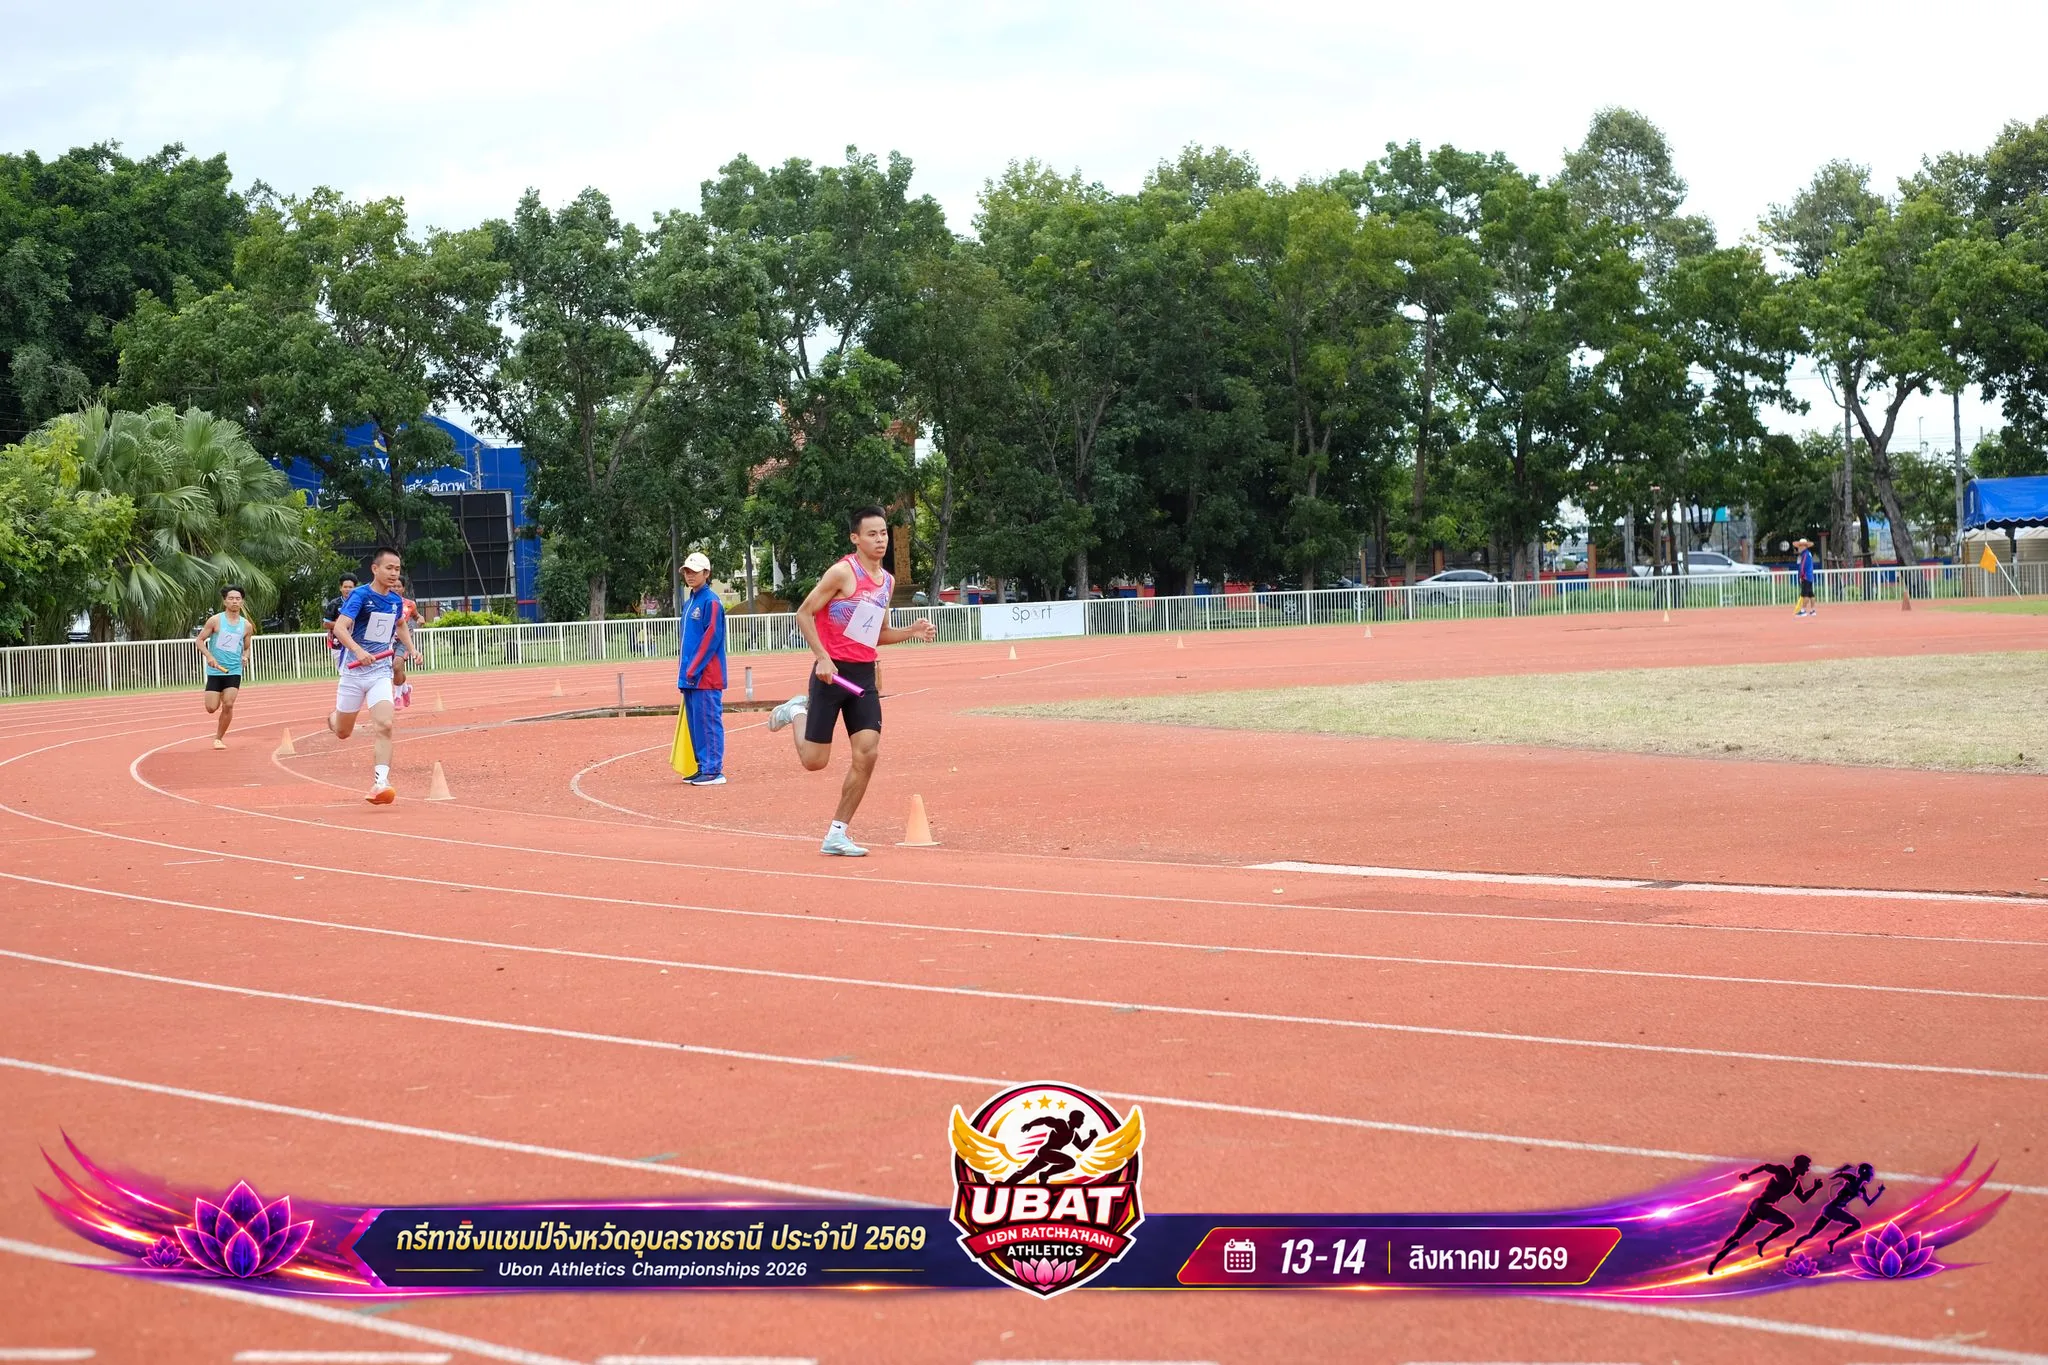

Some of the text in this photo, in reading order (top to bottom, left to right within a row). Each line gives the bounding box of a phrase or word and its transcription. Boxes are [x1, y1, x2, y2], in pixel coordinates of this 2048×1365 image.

[374, 618, 388, 637] 5
[862, 615, 874, 633] 4
[222, 634, 233, 648] 2
